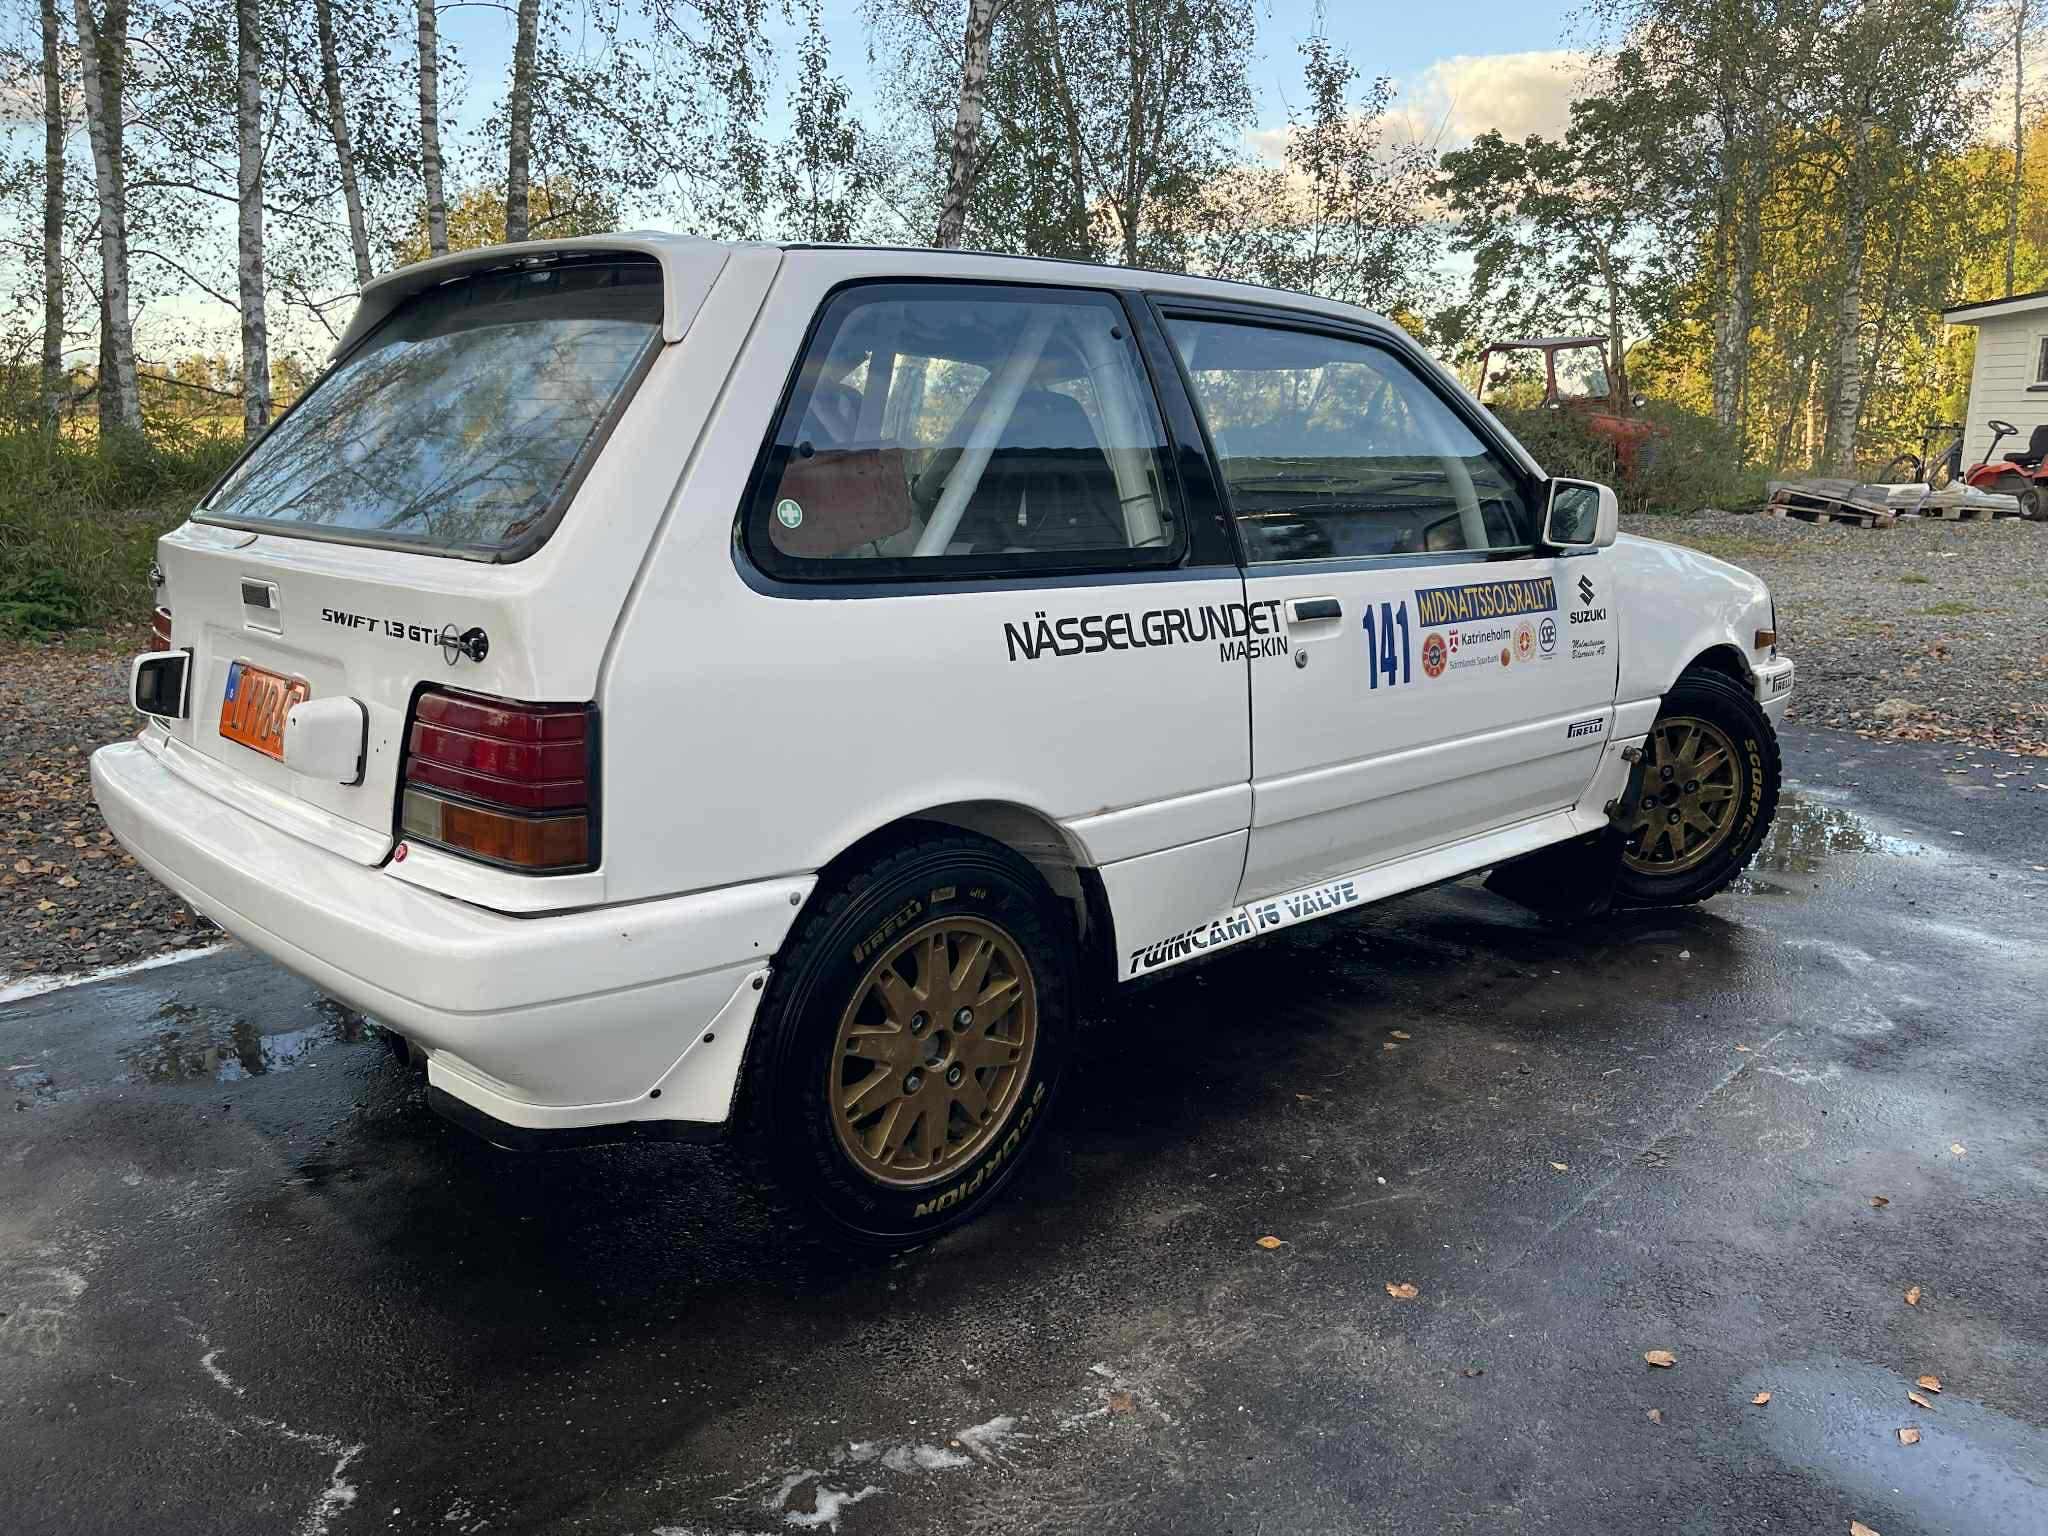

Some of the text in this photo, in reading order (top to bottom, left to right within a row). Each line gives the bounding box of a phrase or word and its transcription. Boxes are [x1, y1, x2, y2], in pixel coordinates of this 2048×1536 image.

[1418, 580, 1555, 624] MIDNATTSSOLSRALLYT
[321, 608, 380, 632] SWIFT
[1570, 608, 1607, 624] SUZUKI
[1004, 600, 1281, 662] NÄSSELGRUNDET
[1461, 627, 1511, 646] Katrineholm
[1220, 636, 1288, 662] MASKIN
[1363, 600, 1411, 690] 141
[1772, 671, 1792, 693] PIRELLI
[1567, 717, 1604, 738] PIRELLI
[1130, 881, 1359, 974] TWINCAM 16 VALVE
